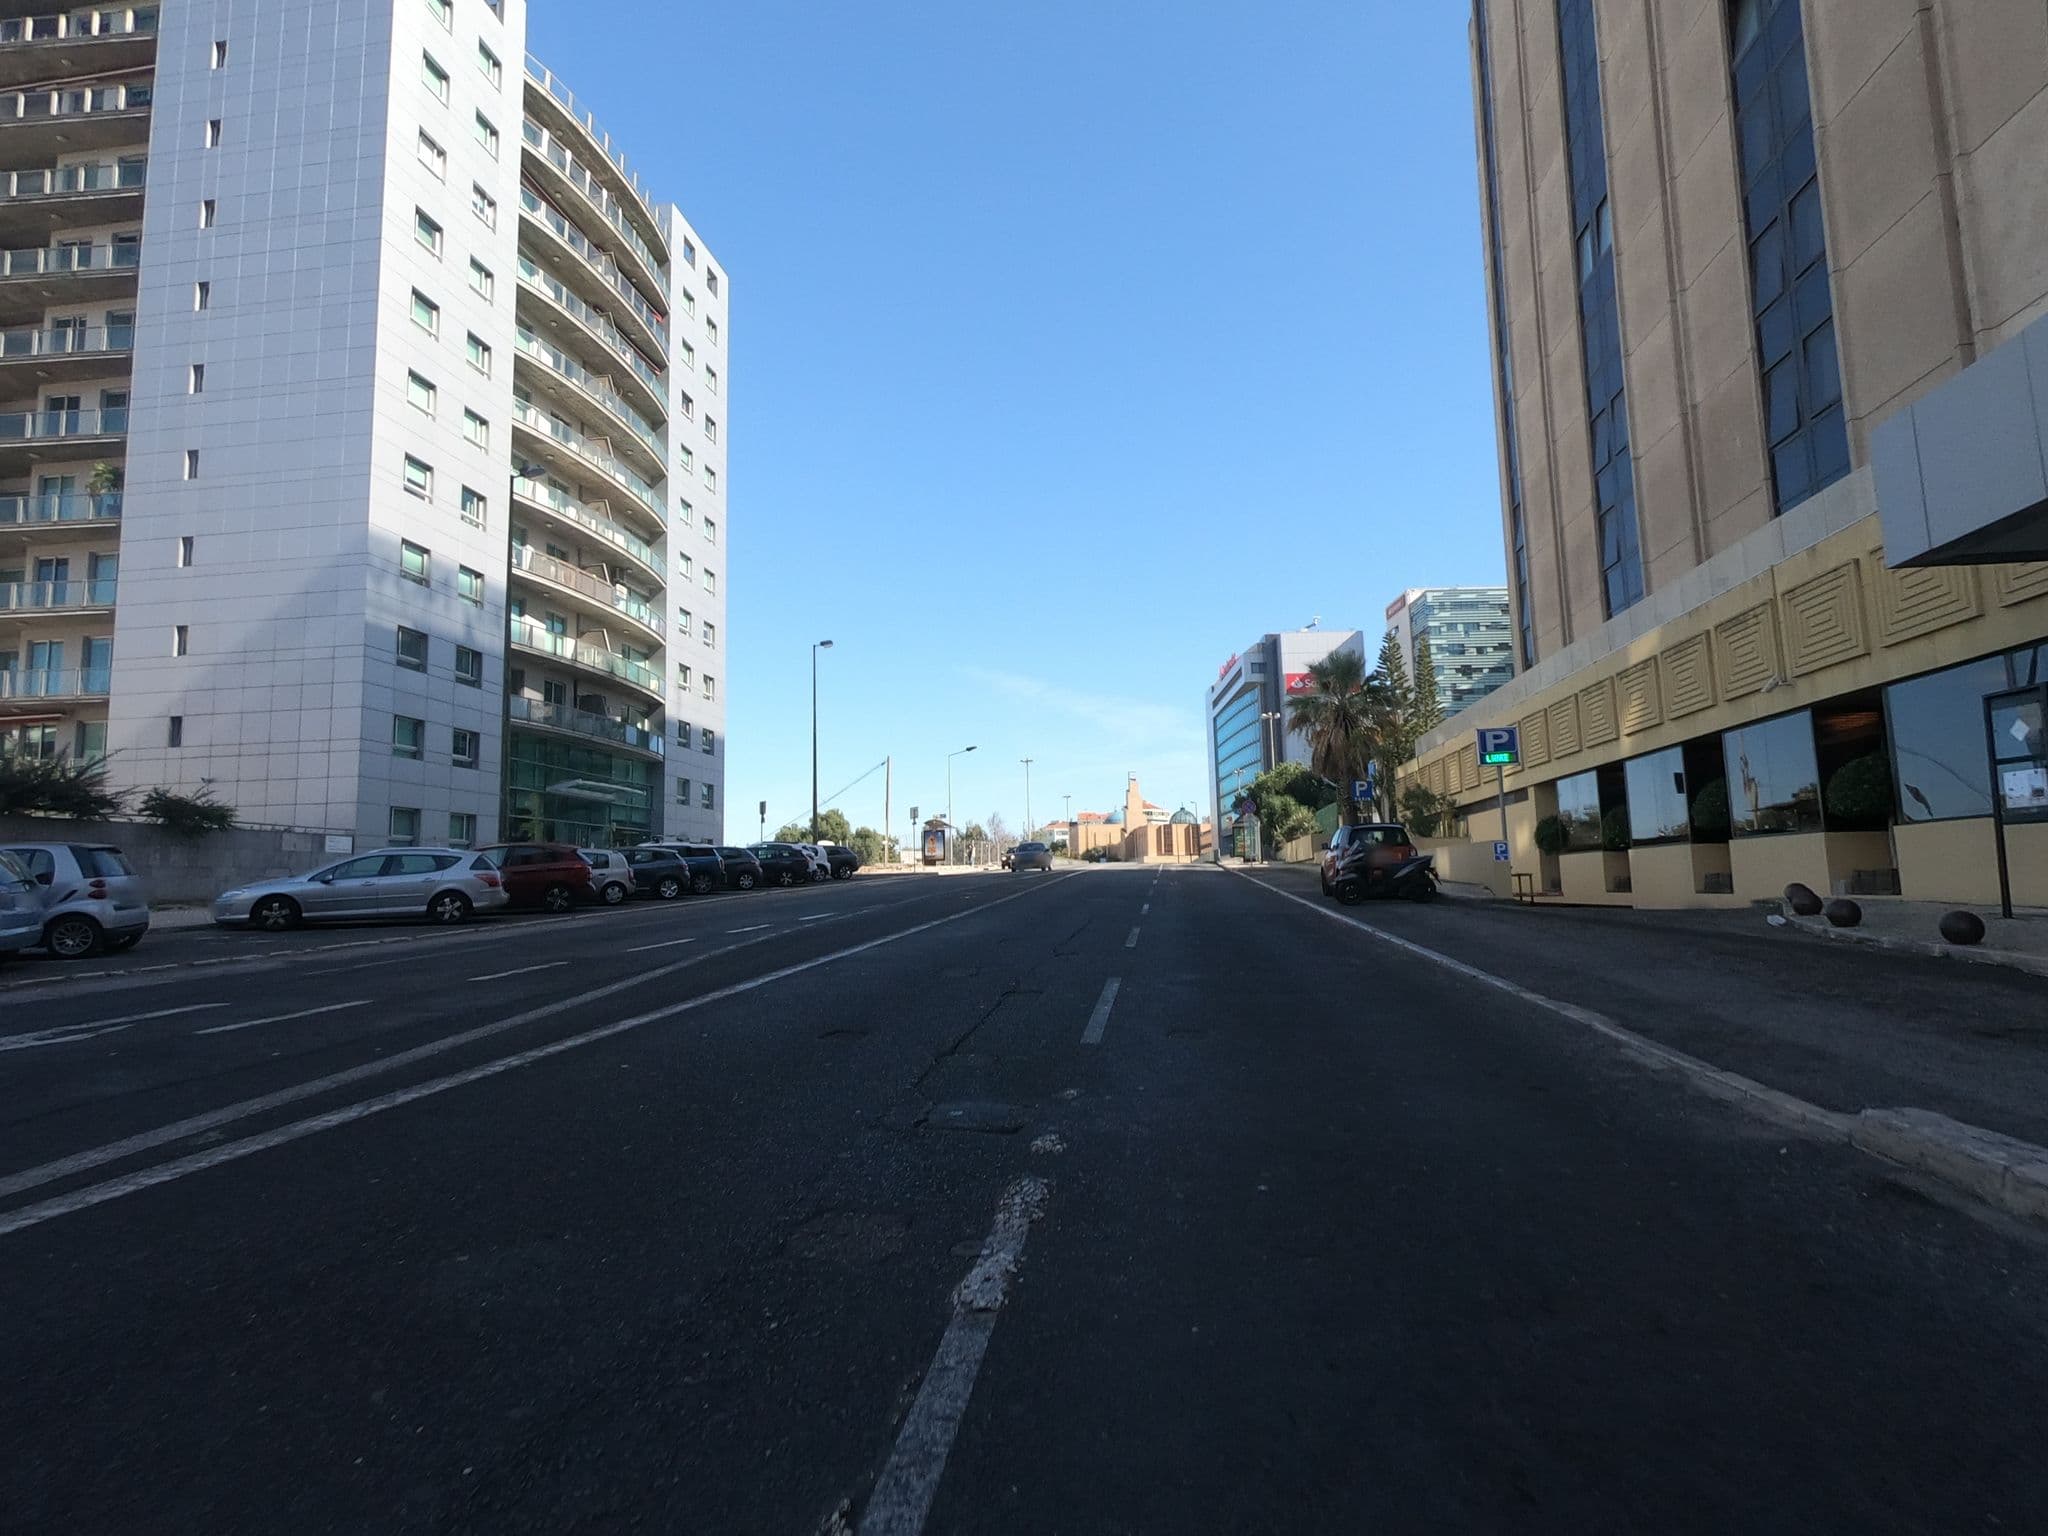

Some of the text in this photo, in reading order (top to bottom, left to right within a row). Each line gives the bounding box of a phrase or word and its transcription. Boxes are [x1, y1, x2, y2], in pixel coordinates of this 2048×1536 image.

[1486, 731, 1509, 751] P
[1356, 781, 1367, 796] P
[1497, 844, 1505, 854] P
